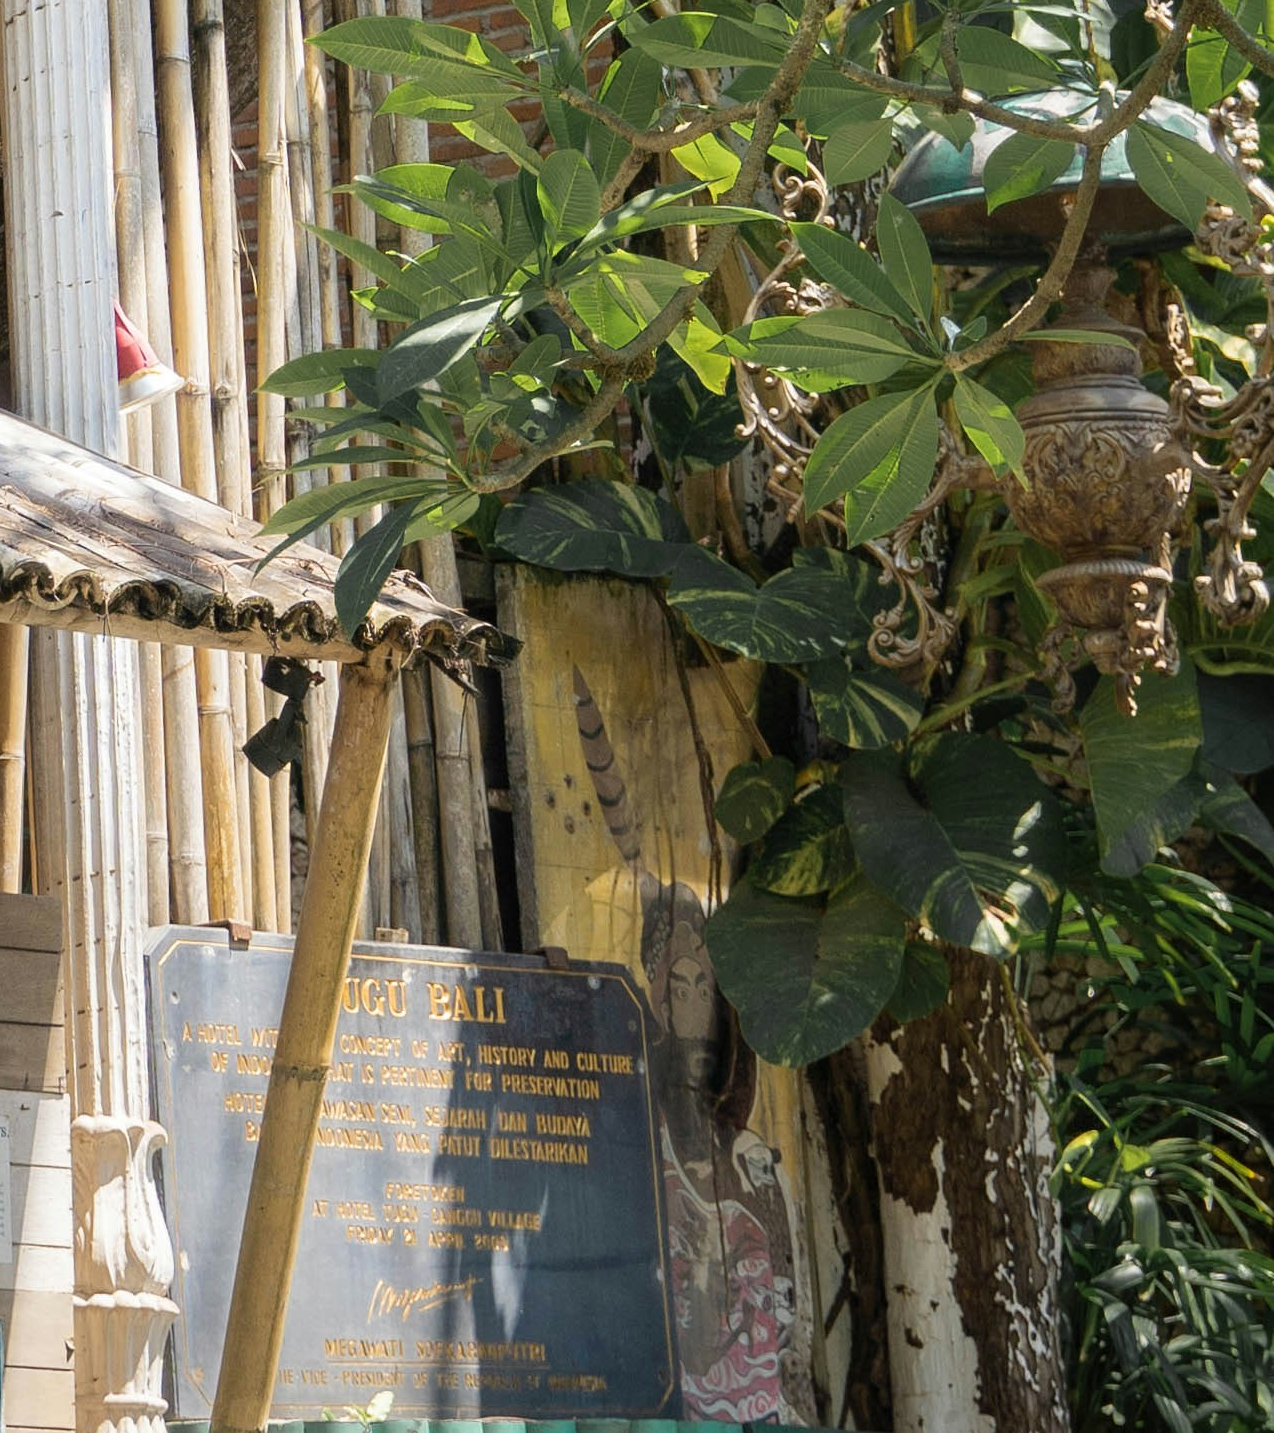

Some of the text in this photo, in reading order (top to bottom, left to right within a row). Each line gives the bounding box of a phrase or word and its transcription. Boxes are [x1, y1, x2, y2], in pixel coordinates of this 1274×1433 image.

[342, 977, 506, 1025] UGU BALI
[197, 1023, 242, 1047] HOTEL
[252, 1027, 279, 1049] WIT
[340, 1034, 401, 1058] CONCEPT
[412, 1039, 429, 1059] OF
[437, 1040, 471, 1066] ART,
[478, 1044, 536, 1069] HISTORY
[543, 1049, 570, 1071] AND
[576, 1052, 635, 1075] CULTURE
[210, 1051, 229, 1073] OF
[236, 1053, 272, 1076] INDO
[361, 1063, 375, 1085] IS
[380, 1064, 454, 1090] PERTINENT
[465, 1071, 493, 1092] FOR
[501, 1073, 601, 1101] PRESERVATION
[223, 1091, 266, 1115] HOTE
[320, 1099, 377, 1123] AWASAN
[423, 1105, 487, 1130] SEJARAH
[498, 1110, 527, 1133] DAN
[536, 1112, 591, 1138] BUDAYA
[316, 1126, 589, 1166] NDONESIA YANG PATUT DILESTARIKAN
[311, 1199, 329, 1218] AT
[336, 1201, 376, 1222] HOTEL
[488, 1210, 542, 1231] VILLAGE
[324, 1337, 404, 1359] MEGAWATI
[300, 1368, 328, 1385] VICE
[342, 1370, 406, 1389] PRESIDENT
[413, 1373, 429, 1389] OF
